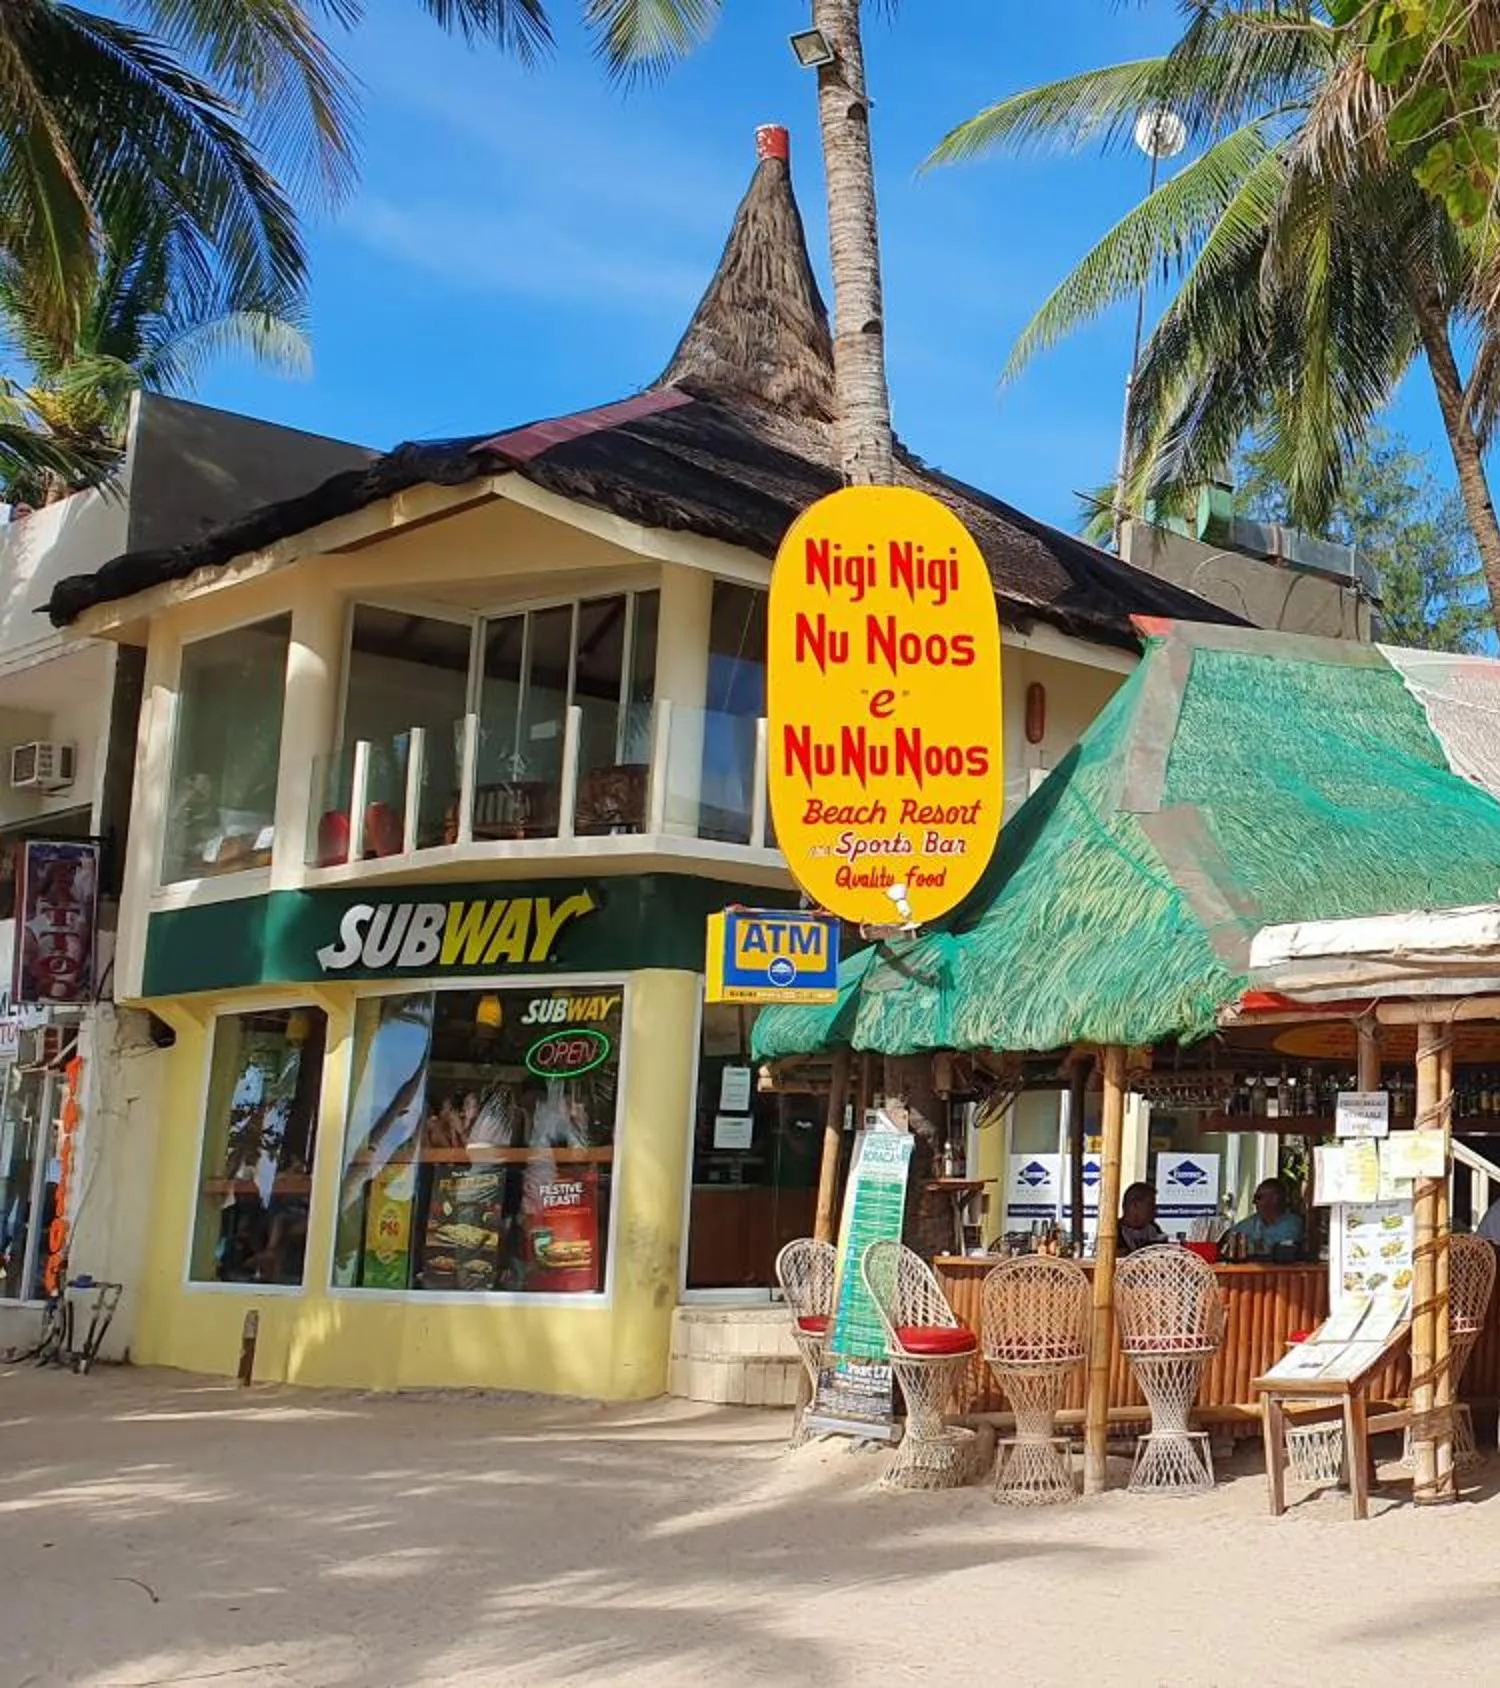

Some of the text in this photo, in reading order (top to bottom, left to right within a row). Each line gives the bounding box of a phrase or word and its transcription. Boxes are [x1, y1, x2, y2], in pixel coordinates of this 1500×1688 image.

[805, 537, 959, 606] Nigi Nigi
[796, 612, 976, 677] Nu Noos
[802, 798, 981, 825] Beach Resort
[835, 831, 912, 862] Sports
[925, 831, 966, 854] Bar
[905, 865, 947, 888] food
[317, 888, 595, 971] SUBWAY
[741, 923, 821, 955] ATM
[521, 994, 620, 1025] SUBWAY
[537, 1040, 599, 1065] OPEN
[539, 1182, 584, 1196] FESTIVE
